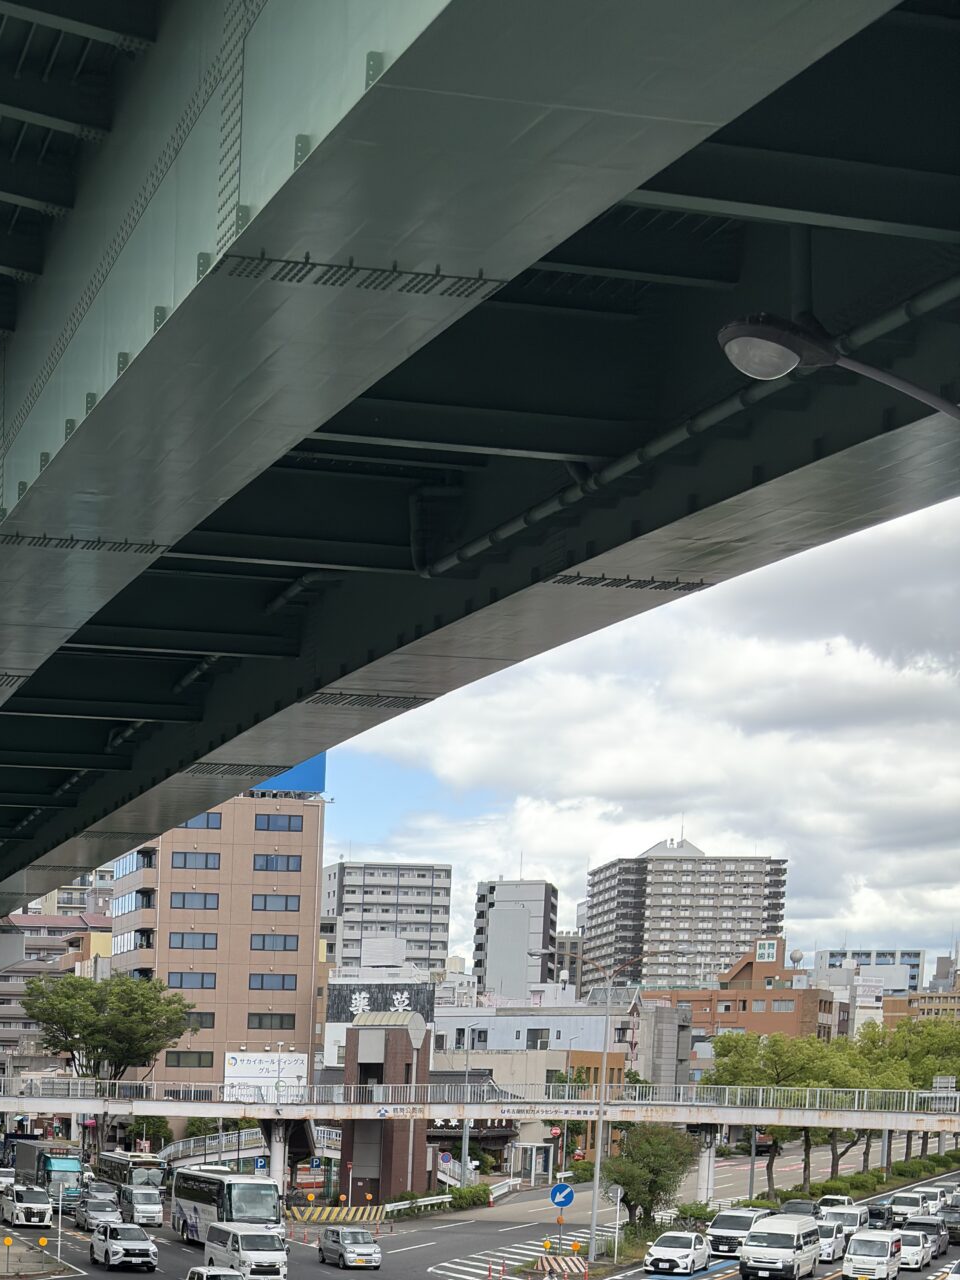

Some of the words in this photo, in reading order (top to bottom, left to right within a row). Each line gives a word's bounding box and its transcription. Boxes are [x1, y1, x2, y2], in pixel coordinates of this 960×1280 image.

[239, 1057, 305, 1066] サカイホールディングス
